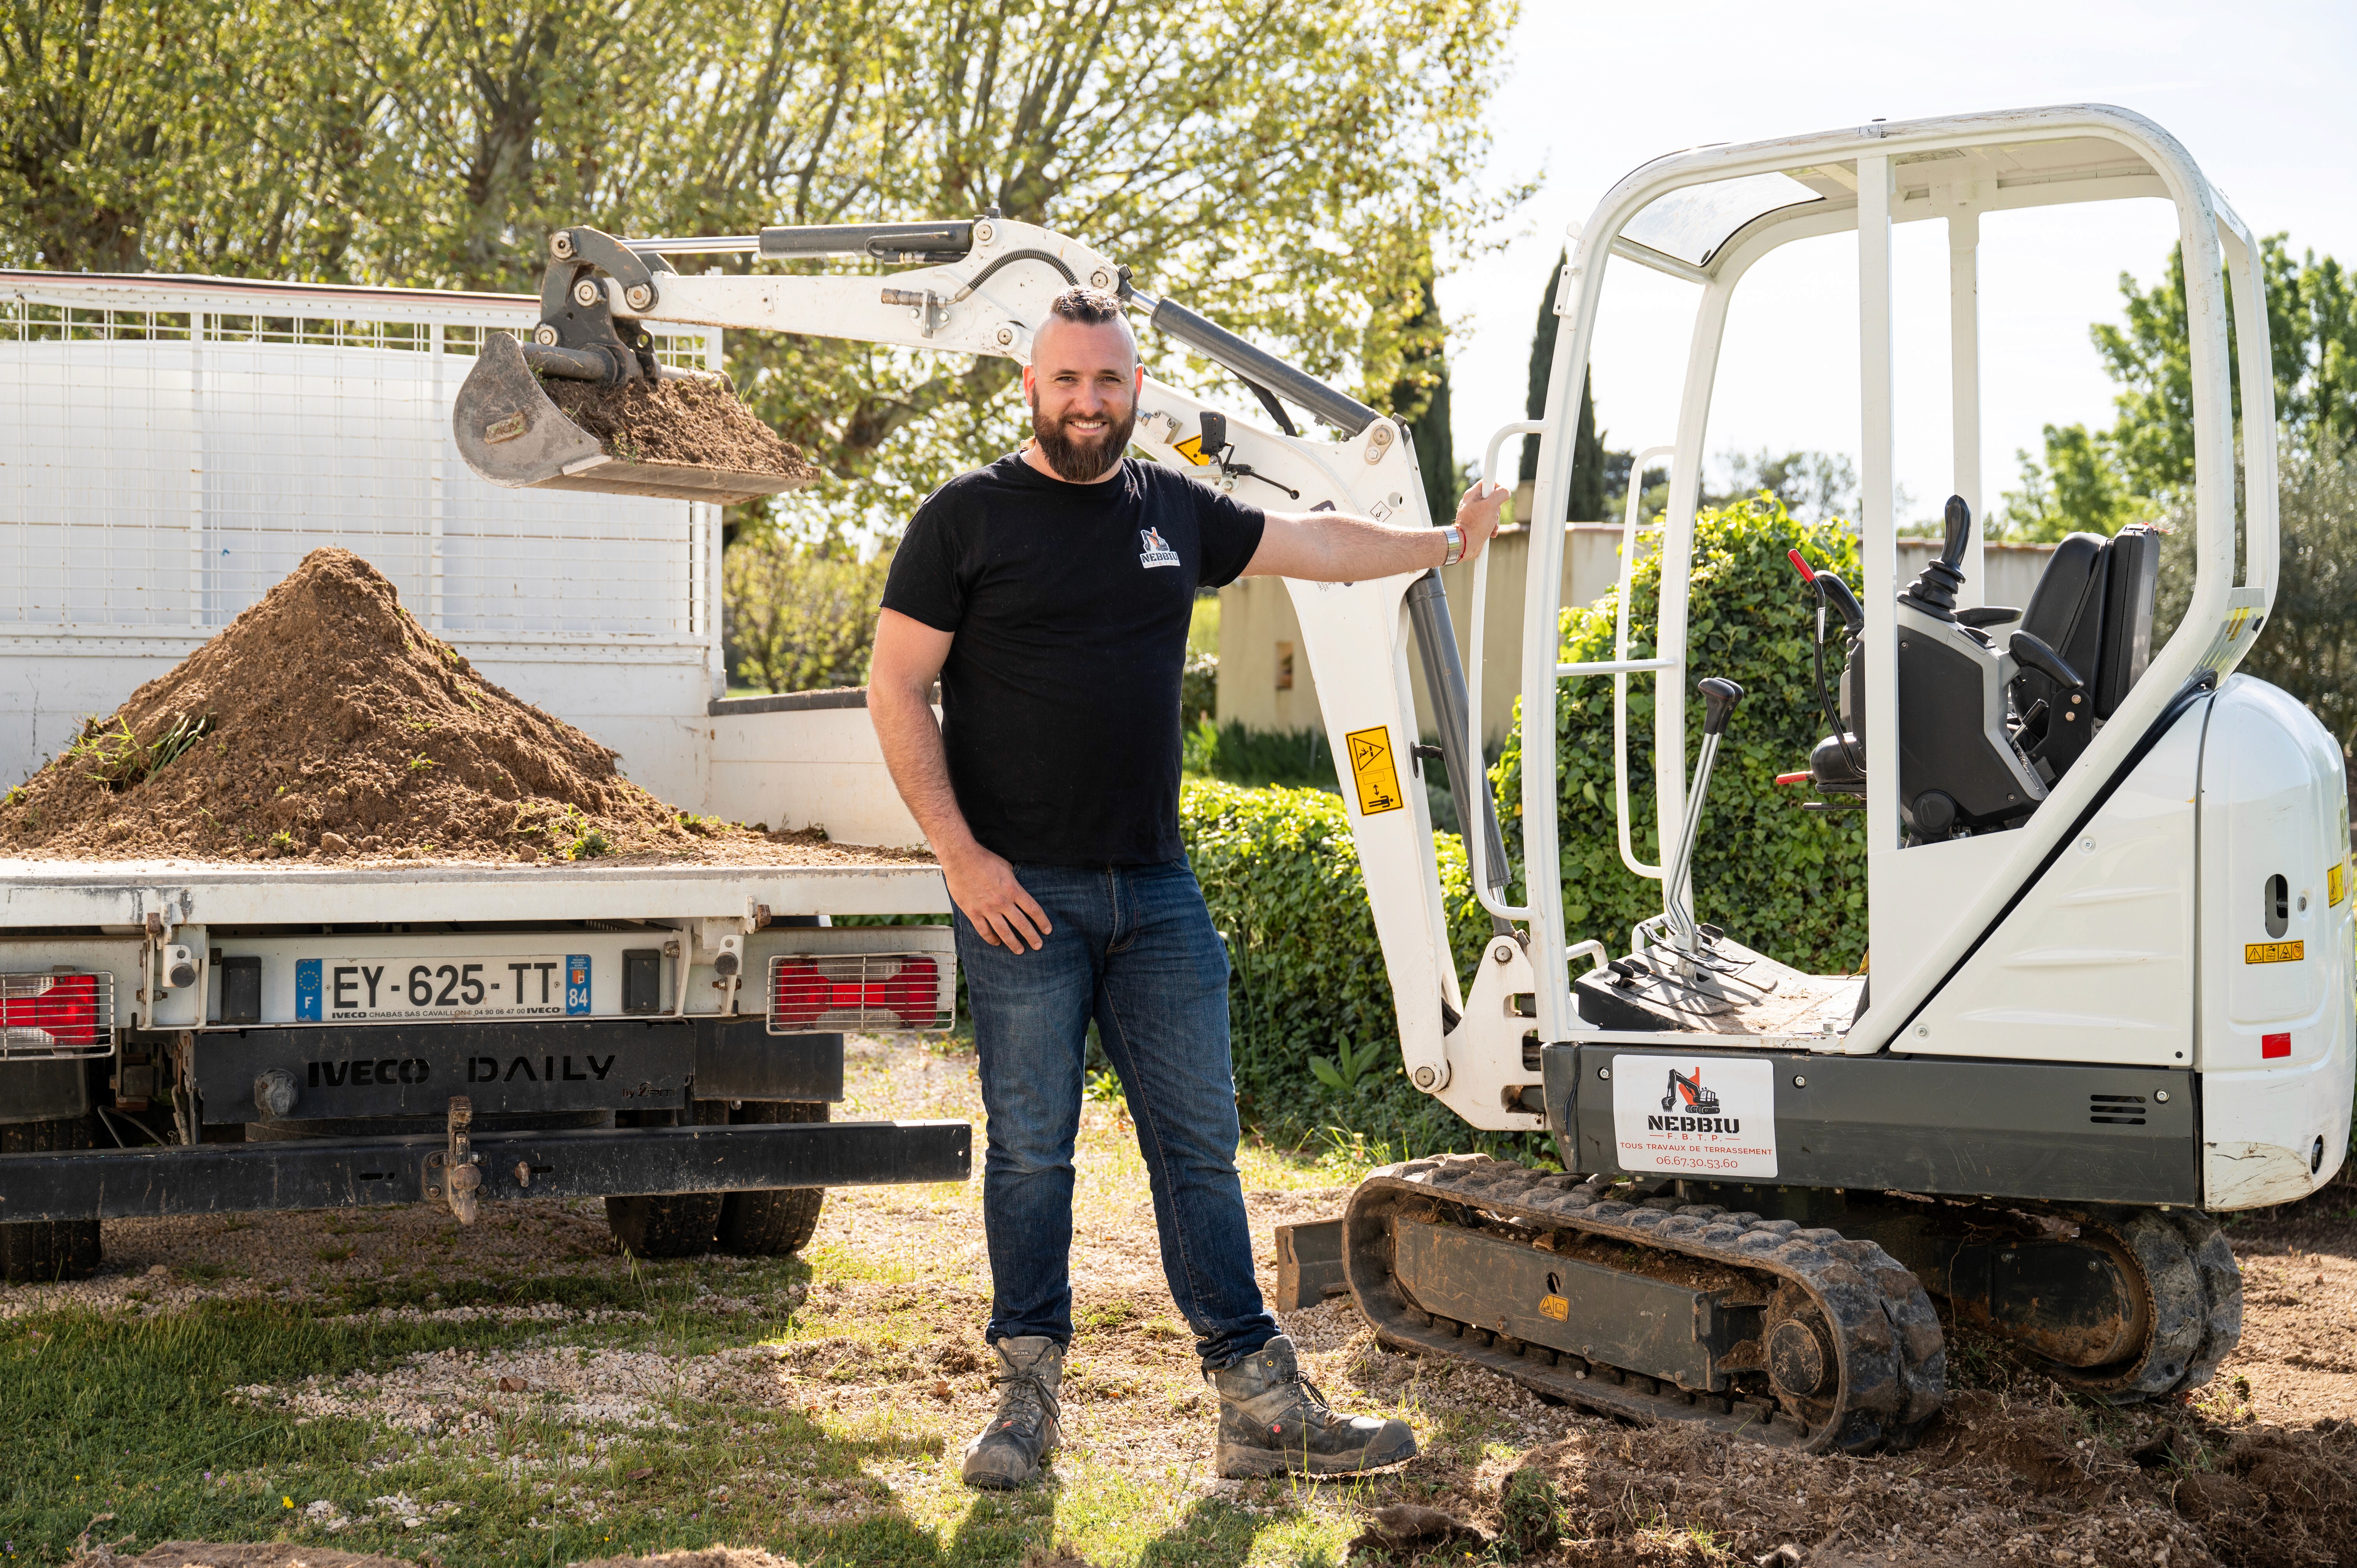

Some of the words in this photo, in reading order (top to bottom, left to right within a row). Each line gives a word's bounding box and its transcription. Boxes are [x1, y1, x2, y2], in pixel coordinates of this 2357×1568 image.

[1141, 552, 1178, 563] NEBBIU
[334, 962, 557, 1008] EY-625-TT
[305, 996, 313, 1009] F
[569, 988, 588, 1007] 84
[308, 1058, 430, 1088] IVECO
[468, 1055, 616, 1083] DAILY
[1648, 1115, 1740, 1134] NEBBIU
[1704, 1146, 1772, 1155] TERRASSEMENT
[1656, 1156, 1738, 1169] 06.67.30.53.60
